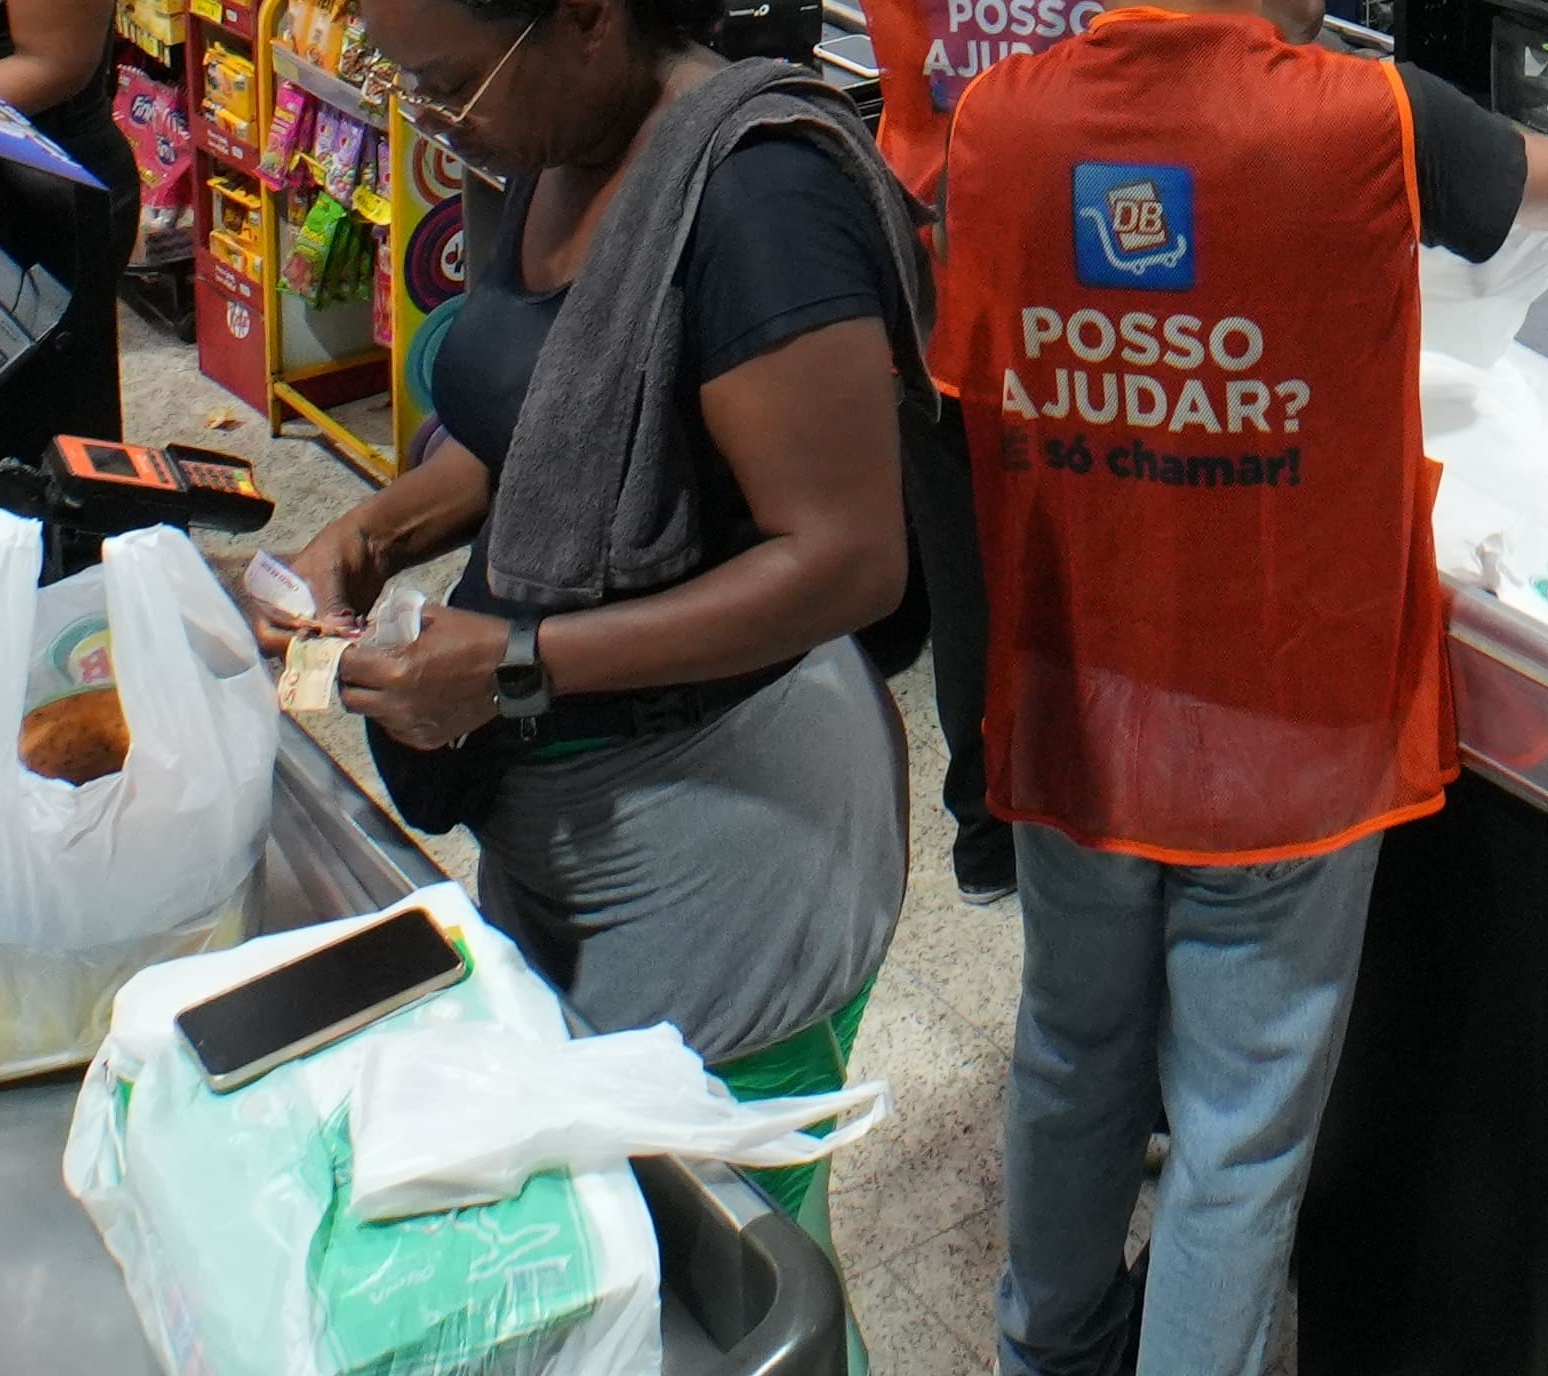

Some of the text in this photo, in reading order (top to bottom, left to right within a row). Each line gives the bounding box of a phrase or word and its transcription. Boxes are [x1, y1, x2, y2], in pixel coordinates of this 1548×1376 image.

[1112, 194, 1166, 238] DB
[1021, 307, 1264, 374] POSSO
[1002, 366, 1311, 435] AJUDAR?
[1108, 438, 1301, 490] chamar!
